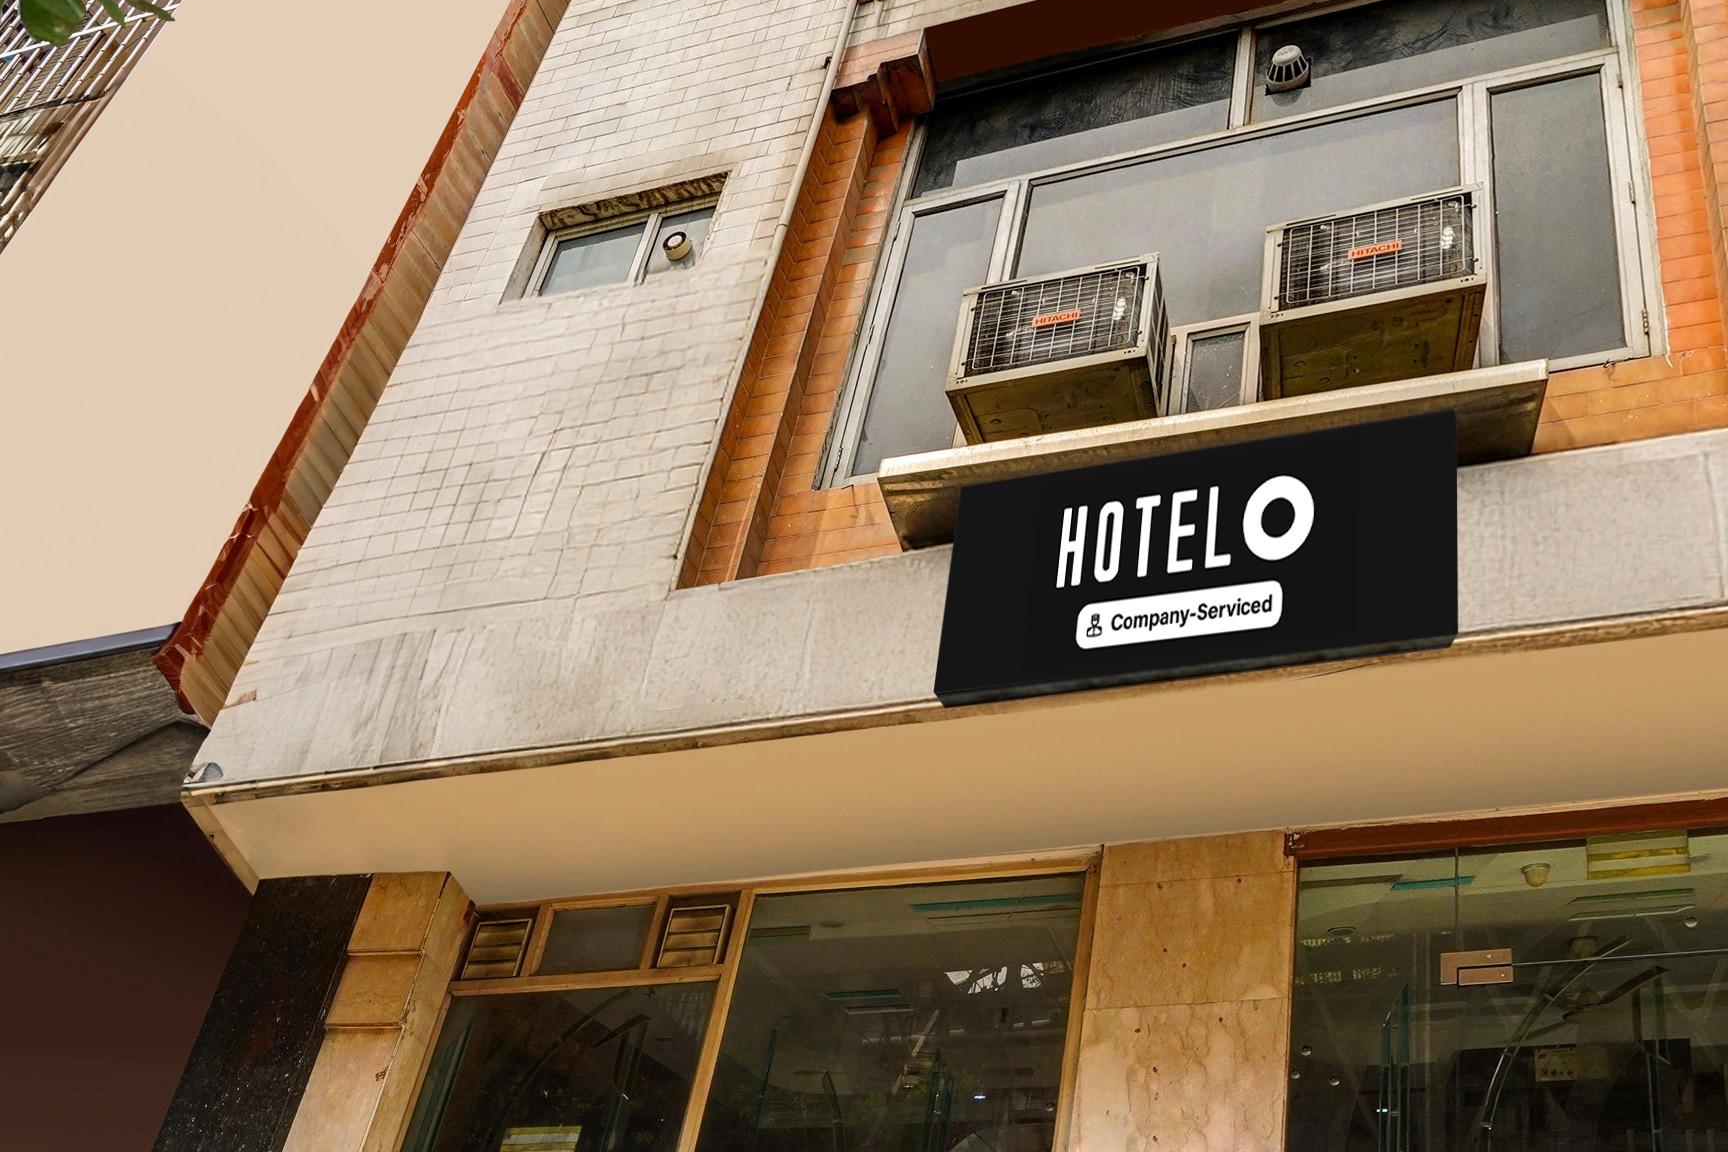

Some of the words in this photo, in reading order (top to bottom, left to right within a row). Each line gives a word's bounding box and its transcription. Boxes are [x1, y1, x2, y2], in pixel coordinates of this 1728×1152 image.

[1351, 242, 1399, 257] HITACHI
[1035, 311, 1078, 324] HITACHI
[1055, 485, 1232, 589] HOTEL
[1110, 594, 1273, 632] Company-Serviced
